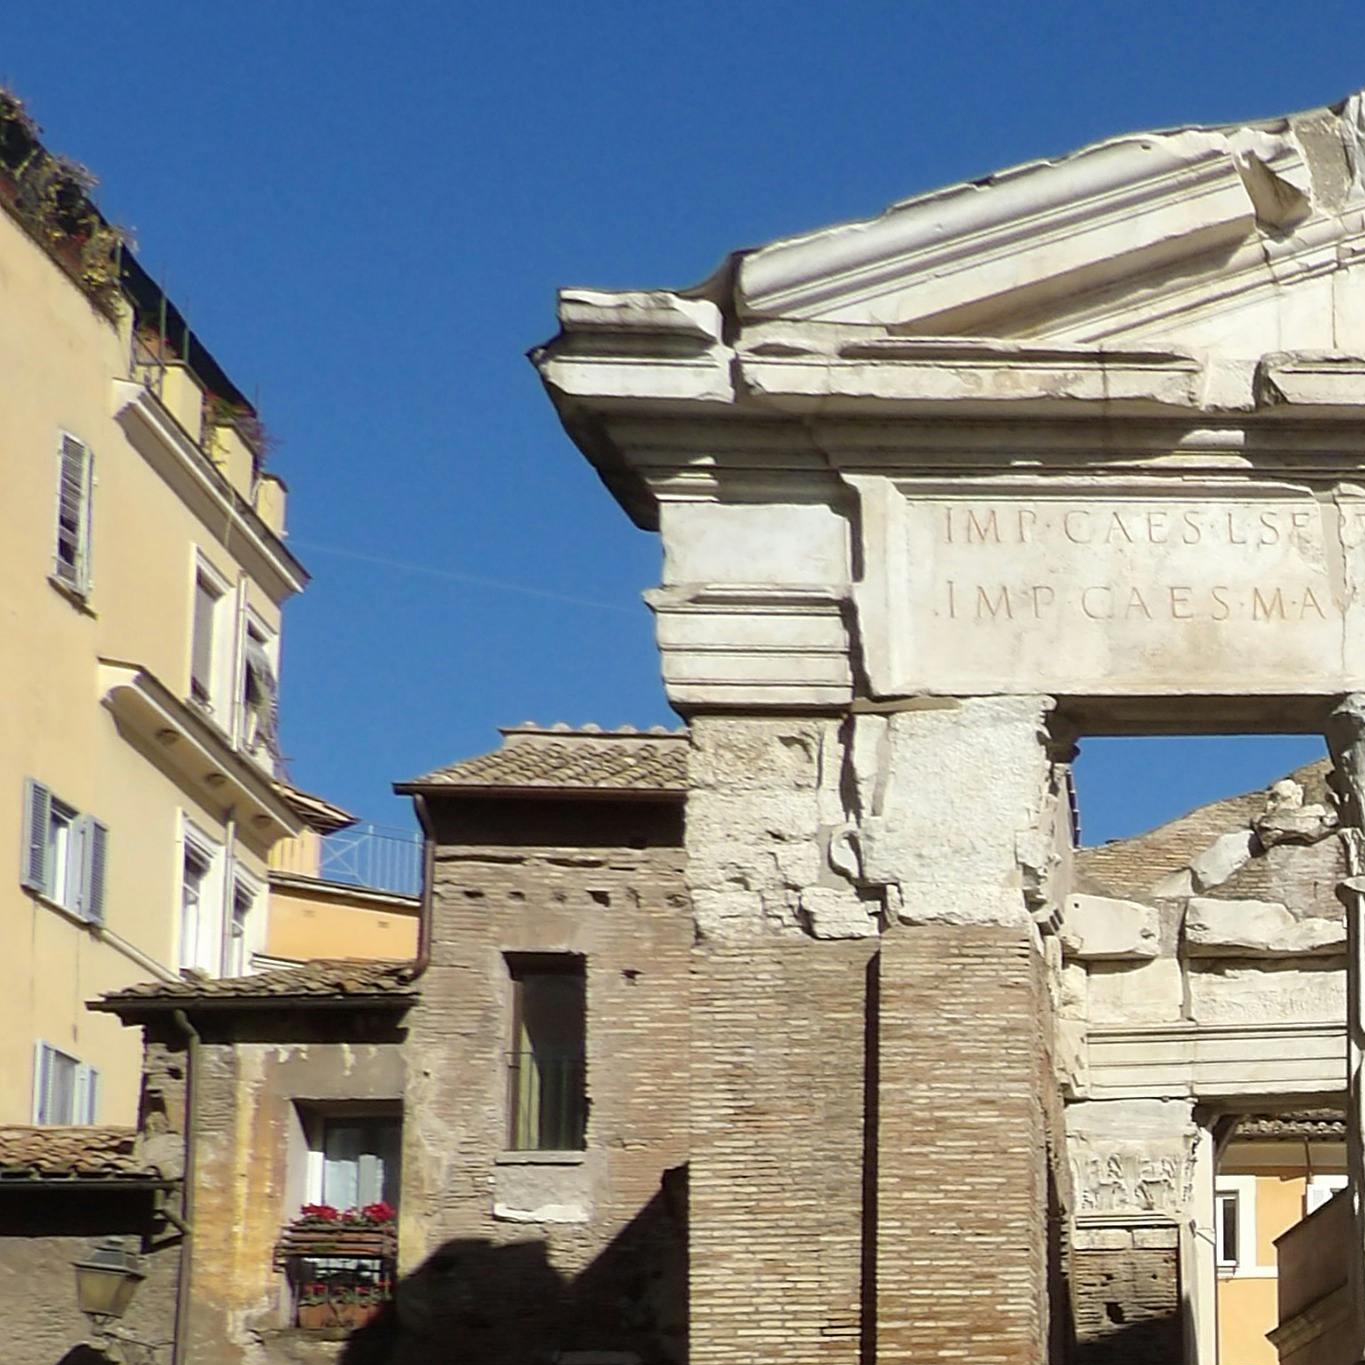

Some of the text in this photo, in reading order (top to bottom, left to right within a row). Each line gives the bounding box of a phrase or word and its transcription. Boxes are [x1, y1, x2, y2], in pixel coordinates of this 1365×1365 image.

[947, 507, 1037, 544] IMP
[1063, 510, 1201, 545] CAES
[1227, 512, 1247, 545] L
[946, 579, 1056, 620] IMP
[1081, 586, 1231, 622] CAES
[1251, 586, 1286, 622] M
